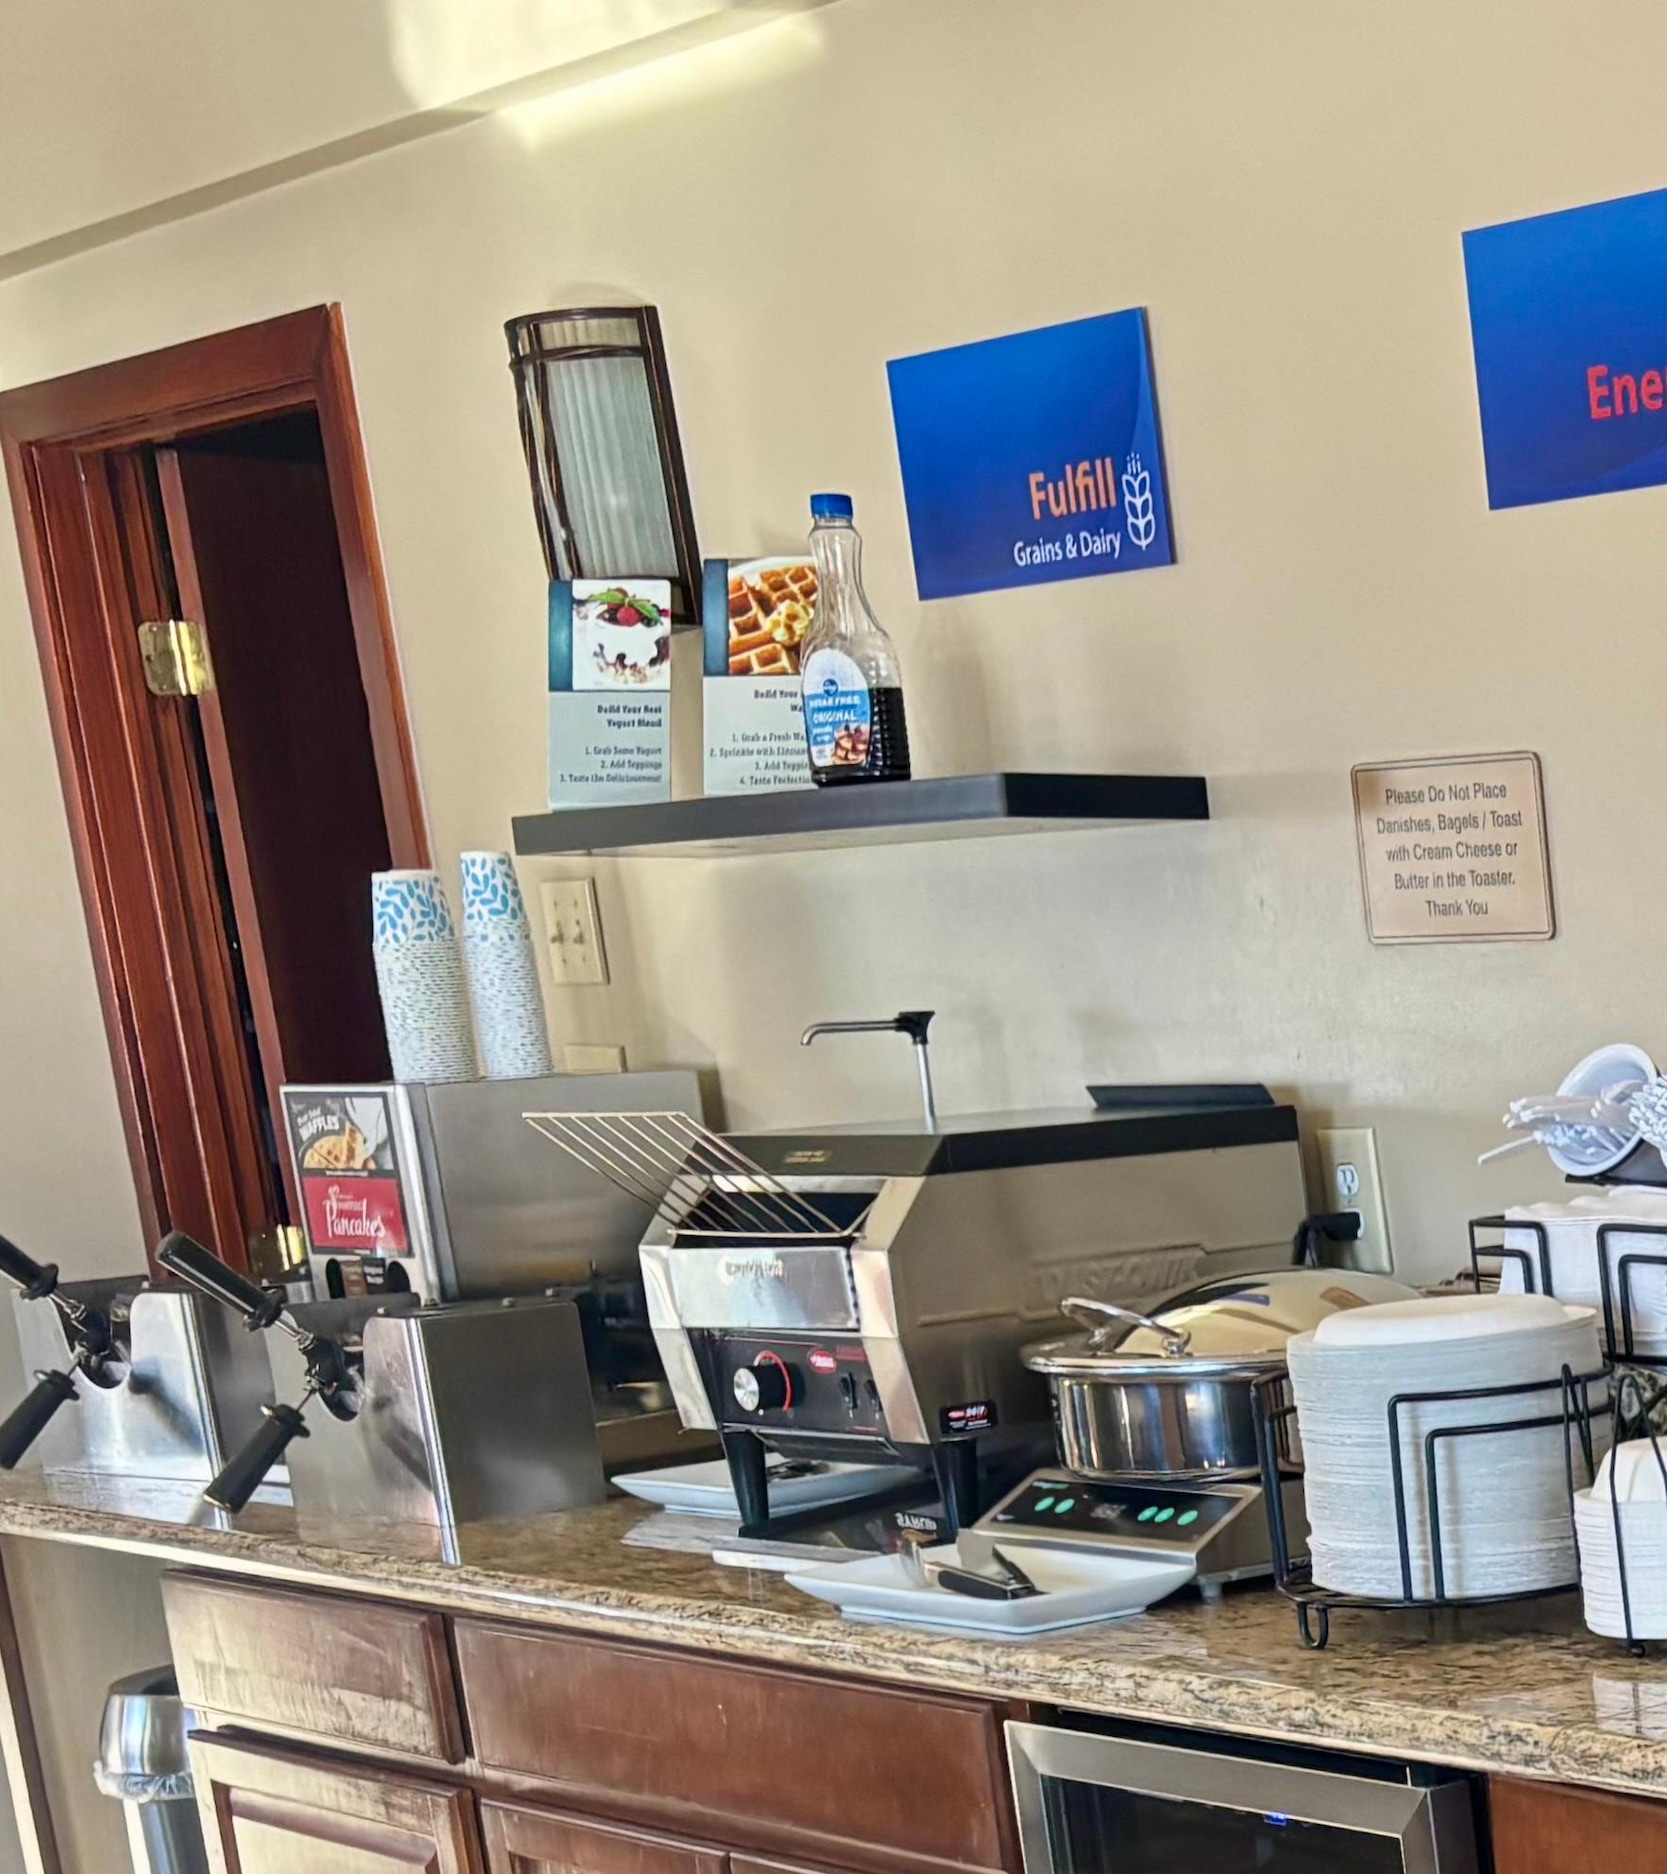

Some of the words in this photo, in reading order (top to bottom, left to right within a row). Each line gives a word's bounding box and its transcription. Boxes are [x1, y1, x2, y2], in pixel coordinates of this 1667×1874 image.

[1029, 457, 1117, 520] Fulfill
[1013, 538, 1063, 567] Grains
[1065, 533, 1078, 558] &
[1080, 528, 1121, 559] Dairy
[1385, 788, 1425, 806] Please
[1428, 786, 1445, 802] Do
[1449, 784, 1470, 801] Not
[1473, 783, 1507, 799] Place
[1376, 817, 1435, 835] Danishes,
[1437, 814, 1479, 834] Bagels
[1482, 810, 1487, 830] /
[1490, 810, 1523, 828] Toast
[1385, 845, 1410, 863] with
[1412, 843, 1453, 861] Cream
[1455, 841, 1503, 859] Cheese
[1505, 842, 1518, 856] or
[1394, 873, 1429, 890] Butter
[1432, 872, 1444, 889] in
[1447, 872, 1466, 888] the
[1468, 870, 1516, 888] Toaster.
[1426, 900, 1463, 917] Thank
[1465, 899, 1489, 916] You
